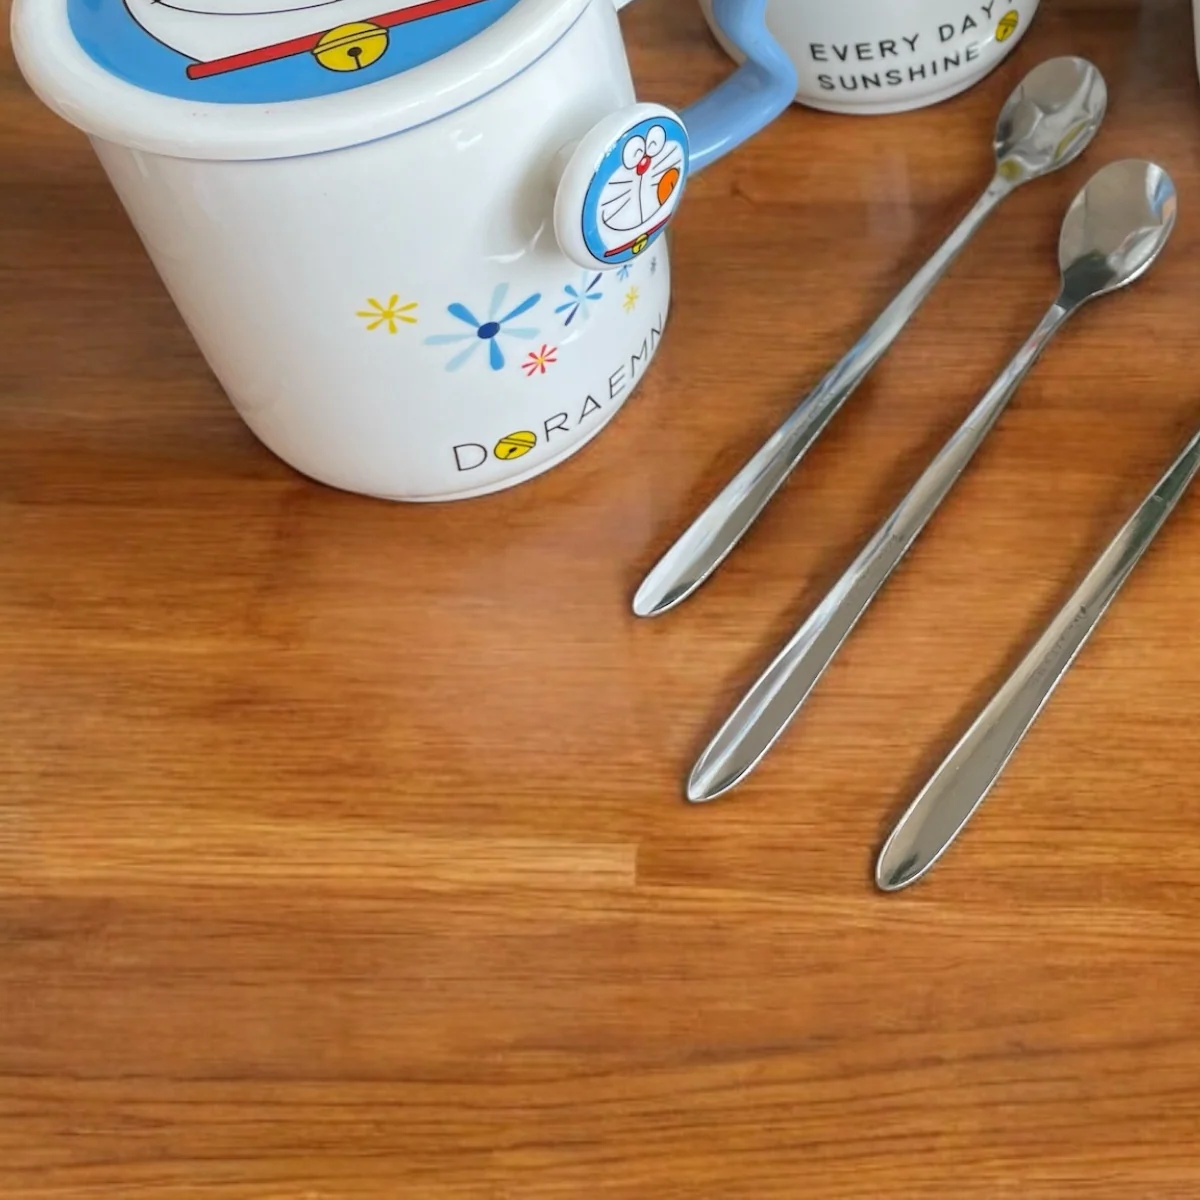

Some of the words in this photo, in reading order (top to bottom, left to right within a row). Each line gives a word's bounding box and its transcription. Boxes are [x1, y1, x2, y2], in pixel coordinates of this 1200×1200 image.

[809, 33, 919, 62] EVERY
[938, 0, 994, 42] DAY
[817, 40, 980, 91] SUNSHINE
